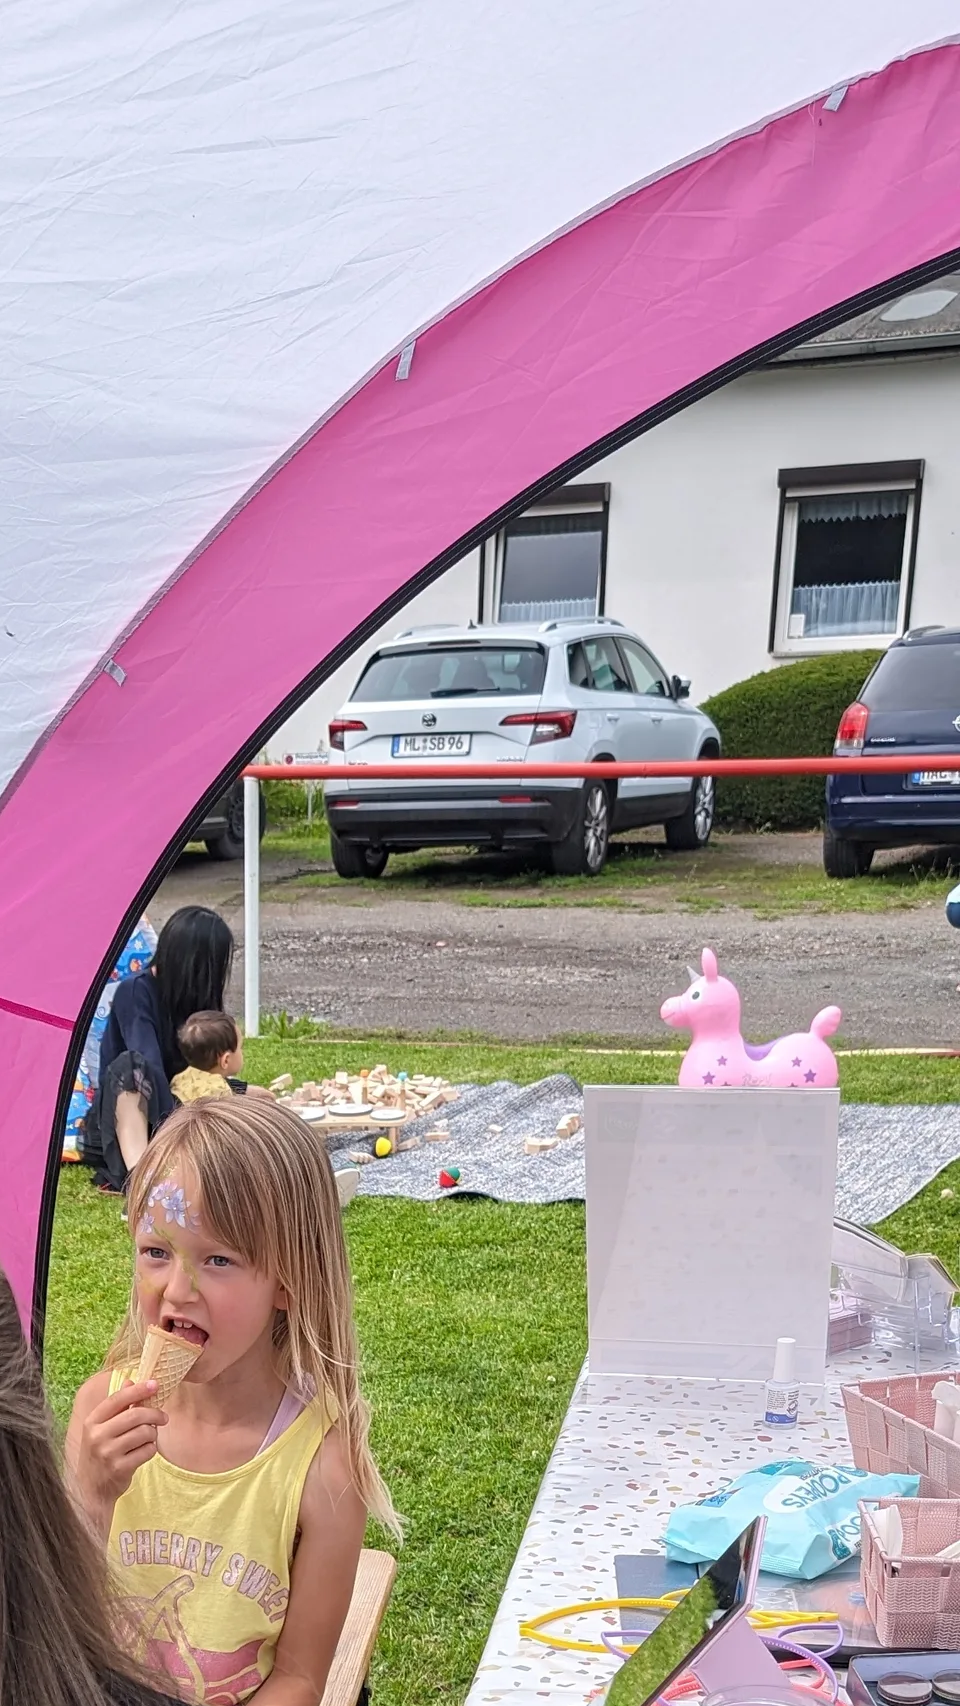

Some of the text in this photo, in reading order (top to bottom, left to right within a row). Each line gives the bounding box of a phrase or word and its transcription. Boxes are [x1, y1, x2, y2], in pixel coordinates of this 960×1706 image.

[404, 735, 463, 751] ML SB 96
[119, 1530, 223, 1577] CHERRY
